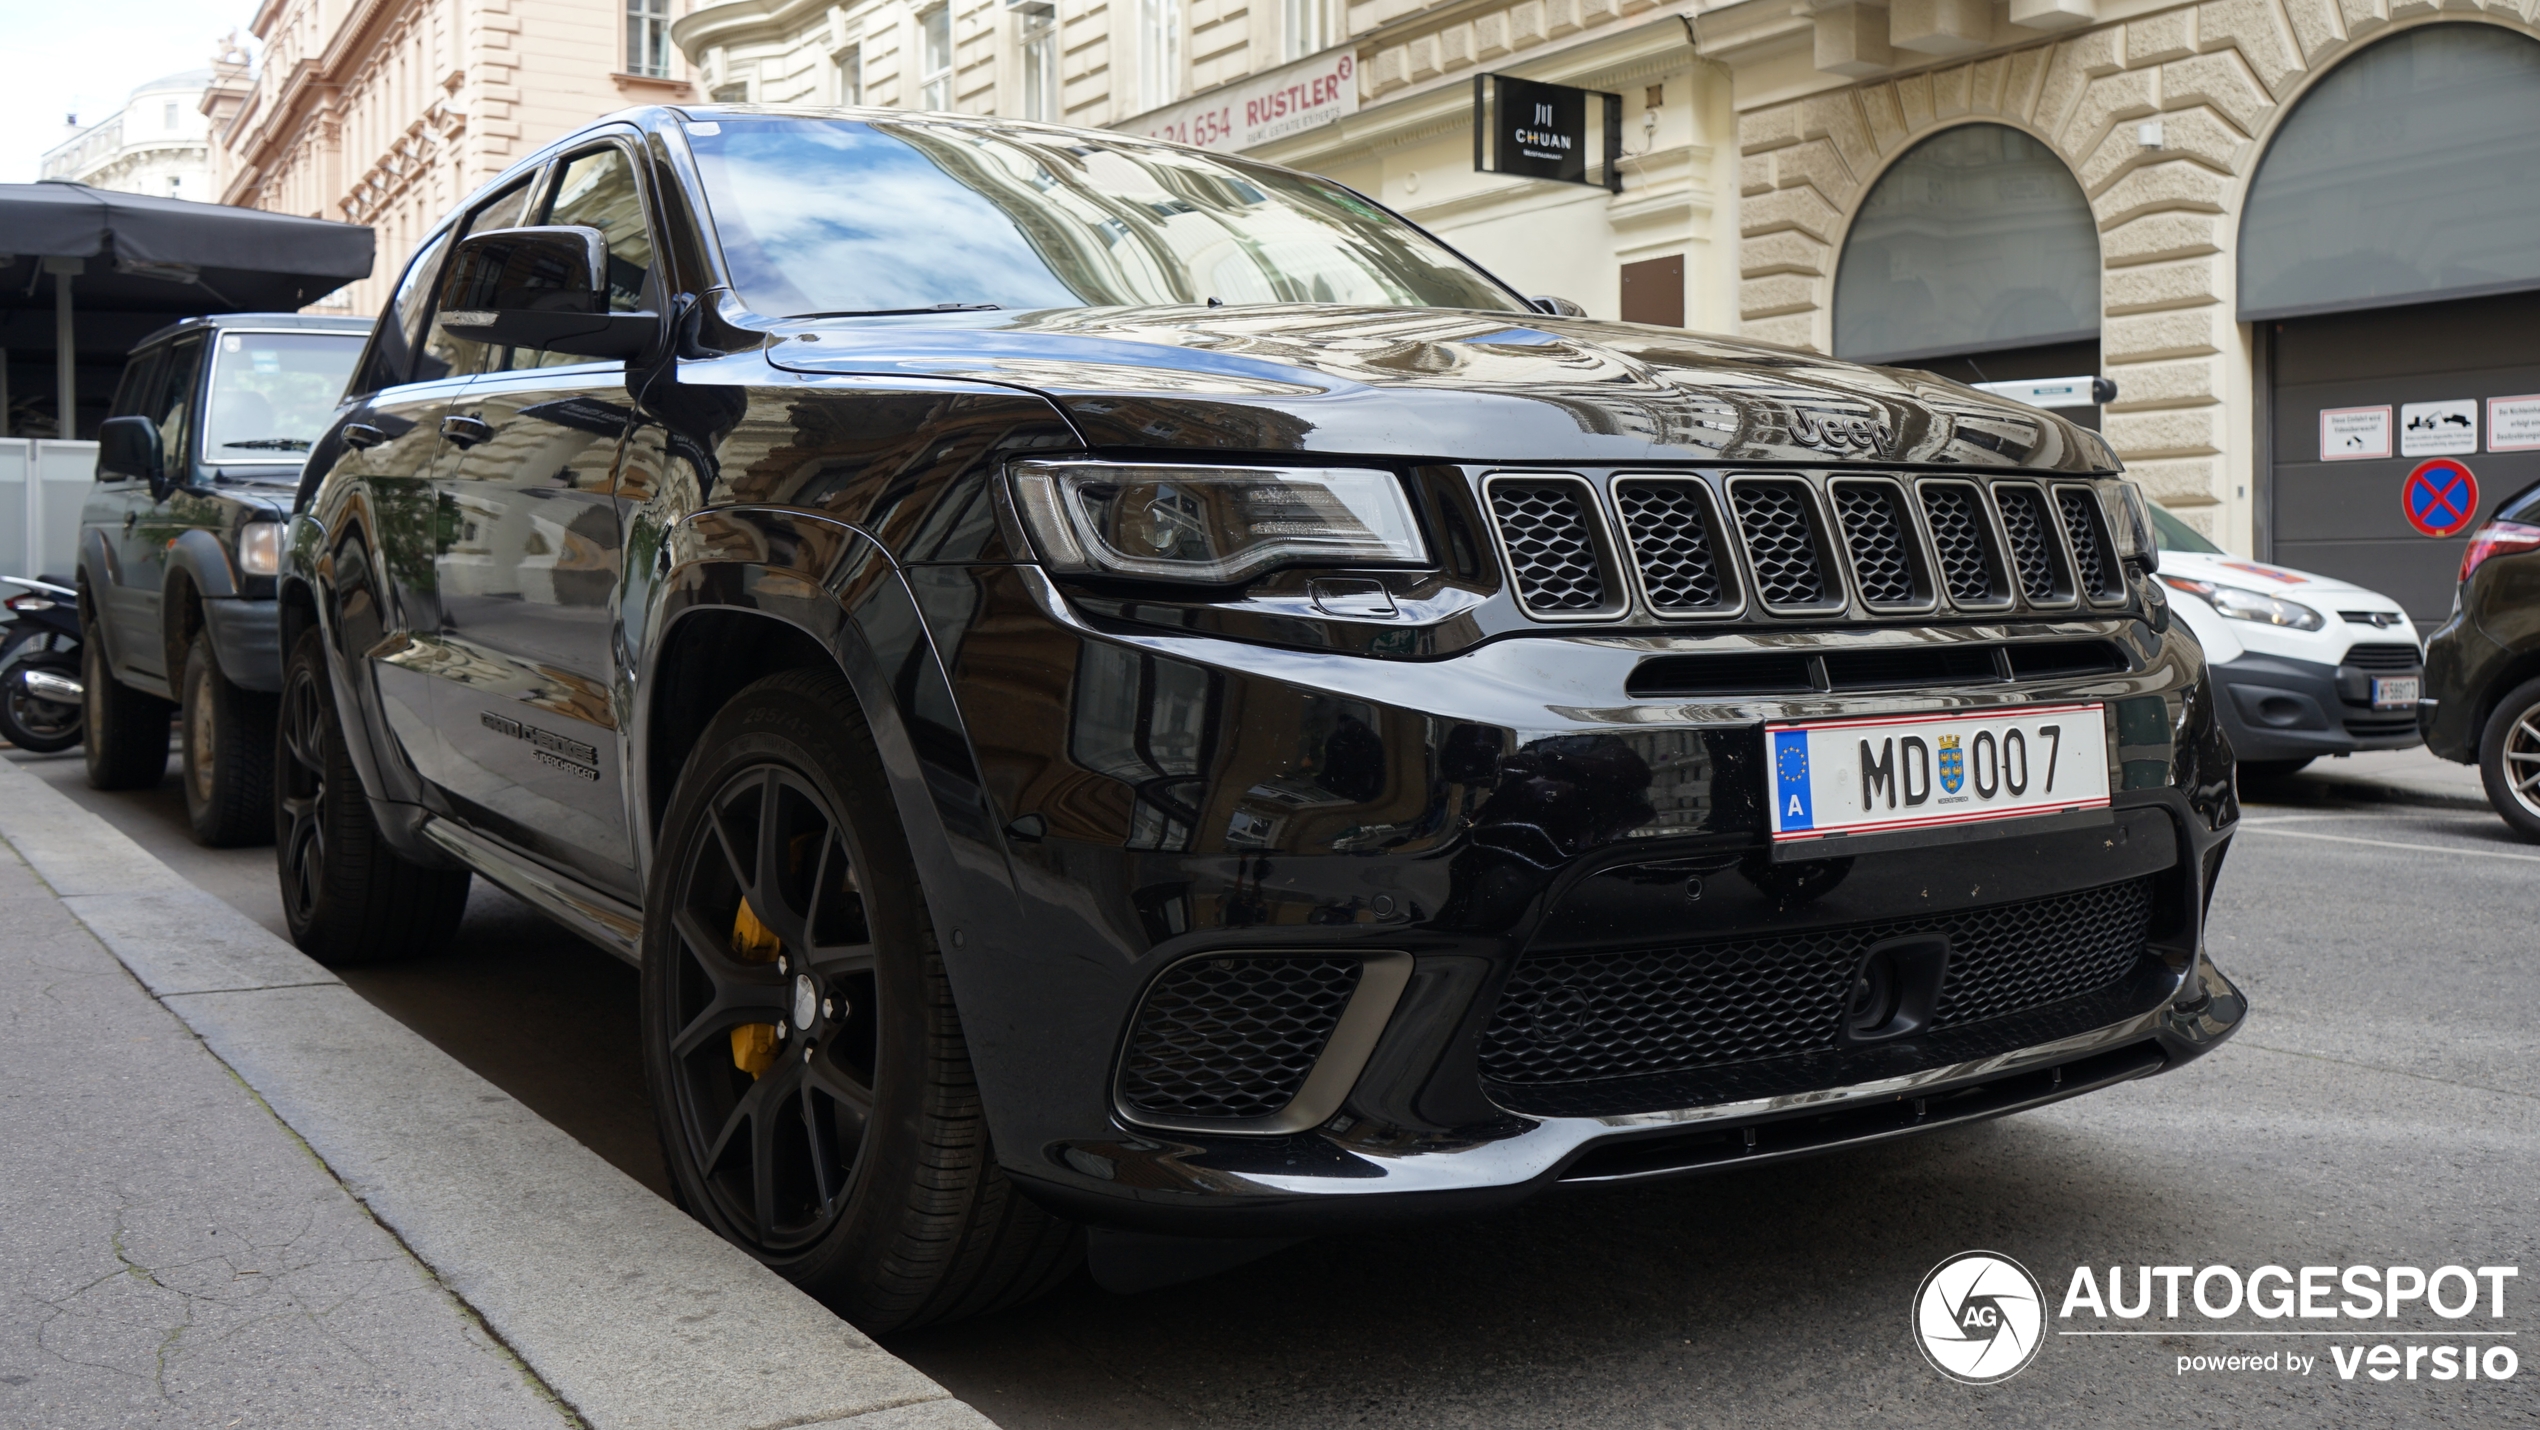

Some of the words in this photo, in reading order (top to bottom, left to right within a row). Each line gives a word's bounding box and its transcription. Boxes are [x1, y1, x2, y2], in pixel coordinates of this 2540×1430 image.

[1246, 74, 1339, 127] RUSTLER
[1194, 107, 1231, 147] 654
[1515, 128, 1571, 149] CHUAN
[1788, 407, 1900, 457] Jeep
[1859, 735, 1931, 811] MD
[1787, 794, 1804, 816] A
